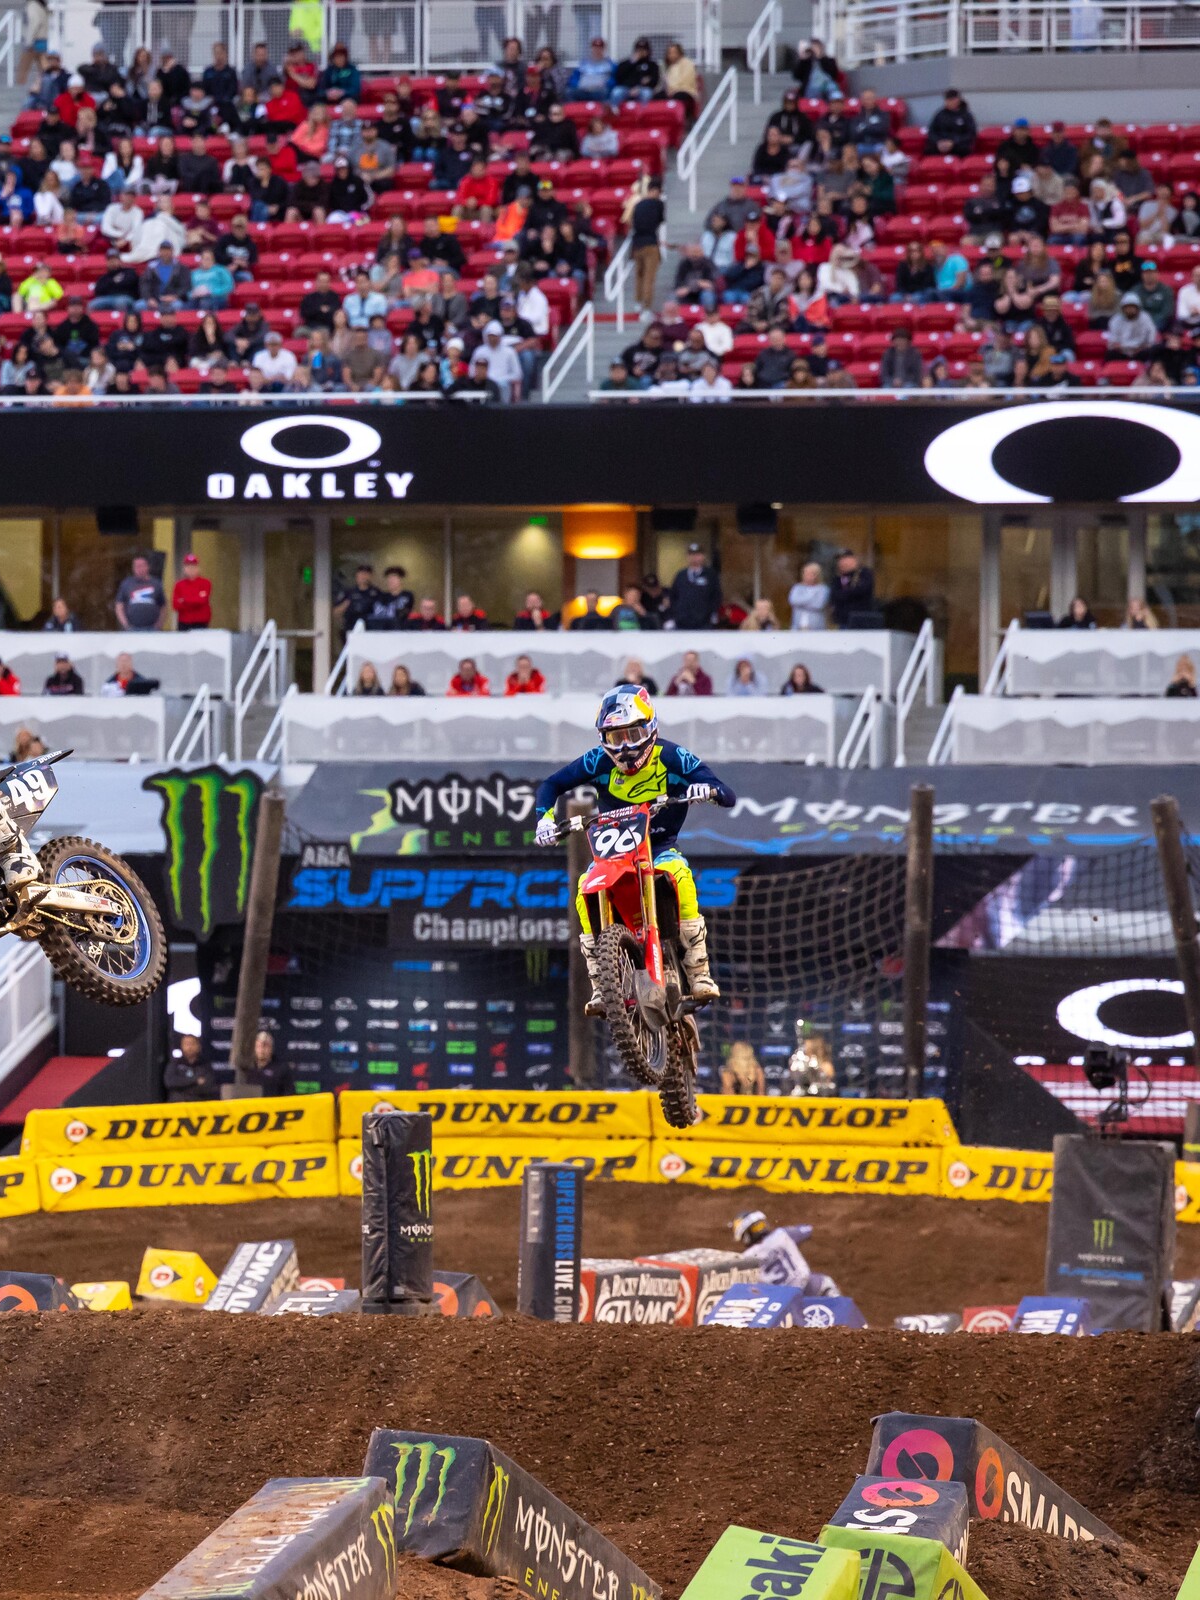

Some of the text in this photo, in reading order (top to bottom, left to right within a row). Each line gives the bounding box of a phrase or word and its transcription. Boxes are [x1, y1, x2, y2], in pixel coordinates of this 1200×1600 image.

[206, 472, 414, 500] OAKLEY
[6, 769, 49, 813] 49
[302, 846, 349, 867] AMA
[594, 823, 642, 859] 96
[288, 868, 740, 909] SUPERCS
[103, 1109, 304, 1141] DUNLOP
[417, 1102, 618, 1124] DUNLOP
[719, 1106, 908, 1128] DUNLOP
[94, 1156, 327, 1190] DUNLOP
[708, 1156, 929, 1184] DUNLOP
[984, 1164, 1053, 1193] DU
[495, 1495, 620, 1600] MONSTER
[294, 1531, 373, 1600] ONSTER
